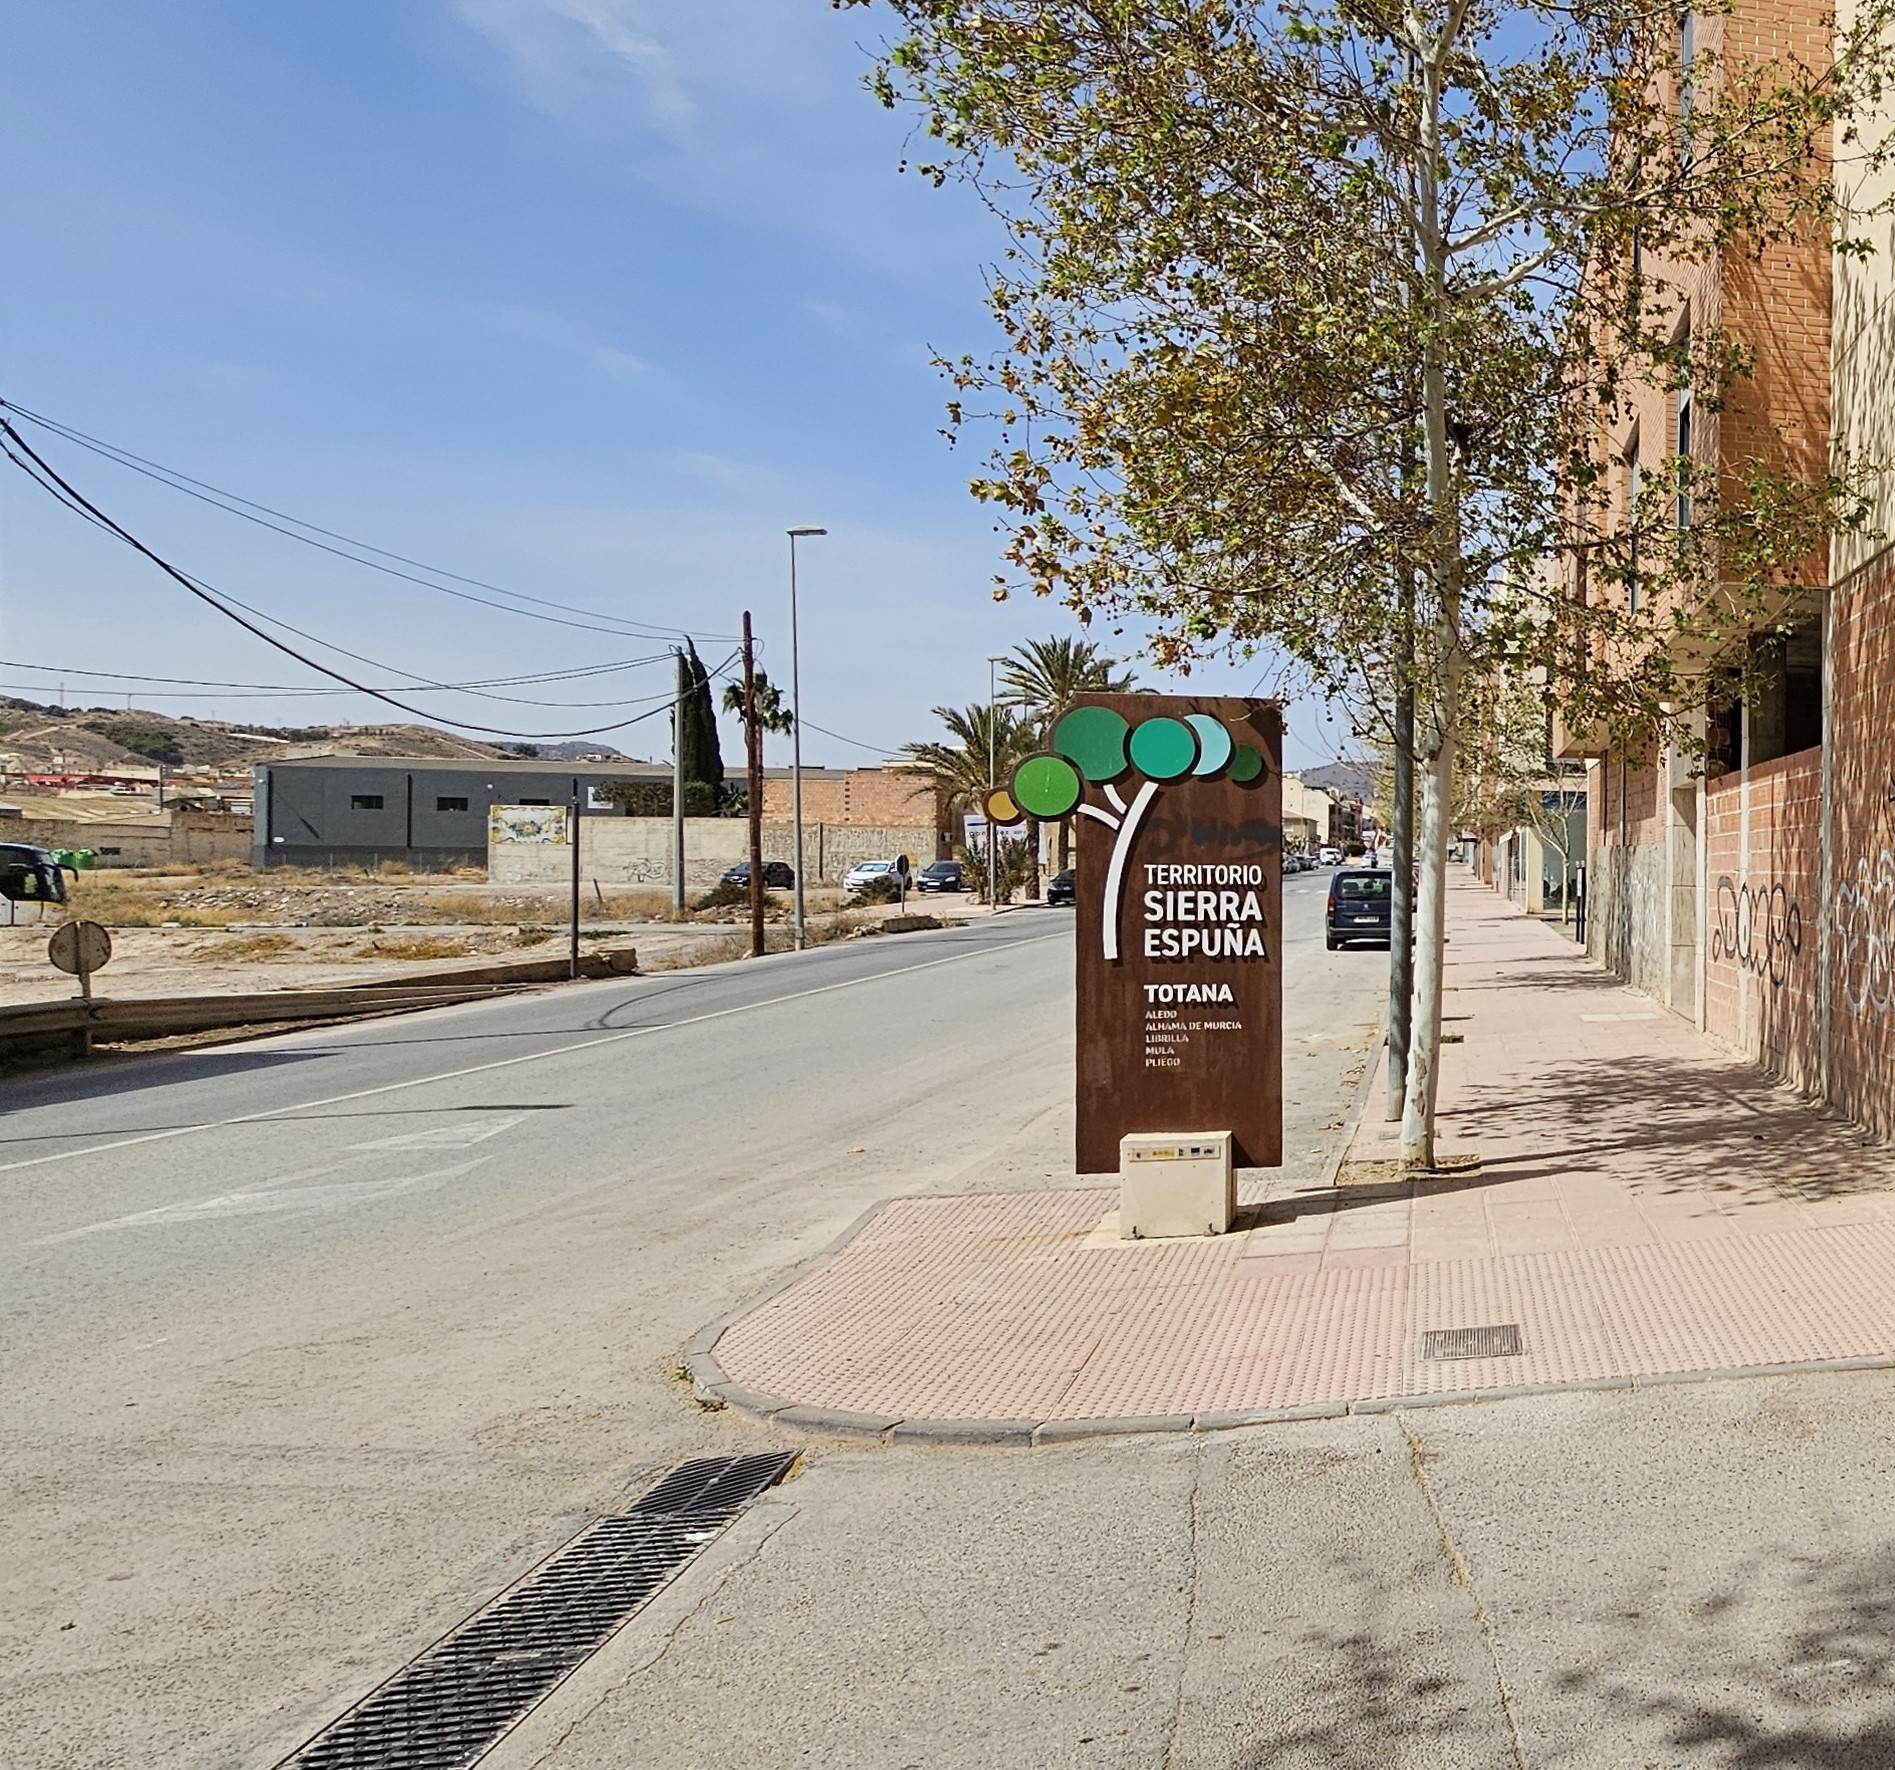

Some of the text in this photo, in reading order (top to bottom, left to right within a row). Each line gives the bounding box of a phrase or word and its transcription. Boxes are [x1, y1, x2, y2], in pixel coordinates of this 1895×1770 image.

[1144, 864, 1262, 885] TERRITORIO
[1144, 890, 1263, 921] SIERRA
[1144, 922, 1265, 957] ESPUÑA
[1143, 983, 1234, 1003] TOTANA
[1145, 1010, 1178, 1019] ALEDO
[1145, 1021, 1242, 1031] ALHAMA DE MURCIA
[1145, 1034, 1190, 1043] LIBRILLA
[1145, 1046, 1175, 1055] MULA
[1145, 1057, 1181, 1067] PLIEGO
